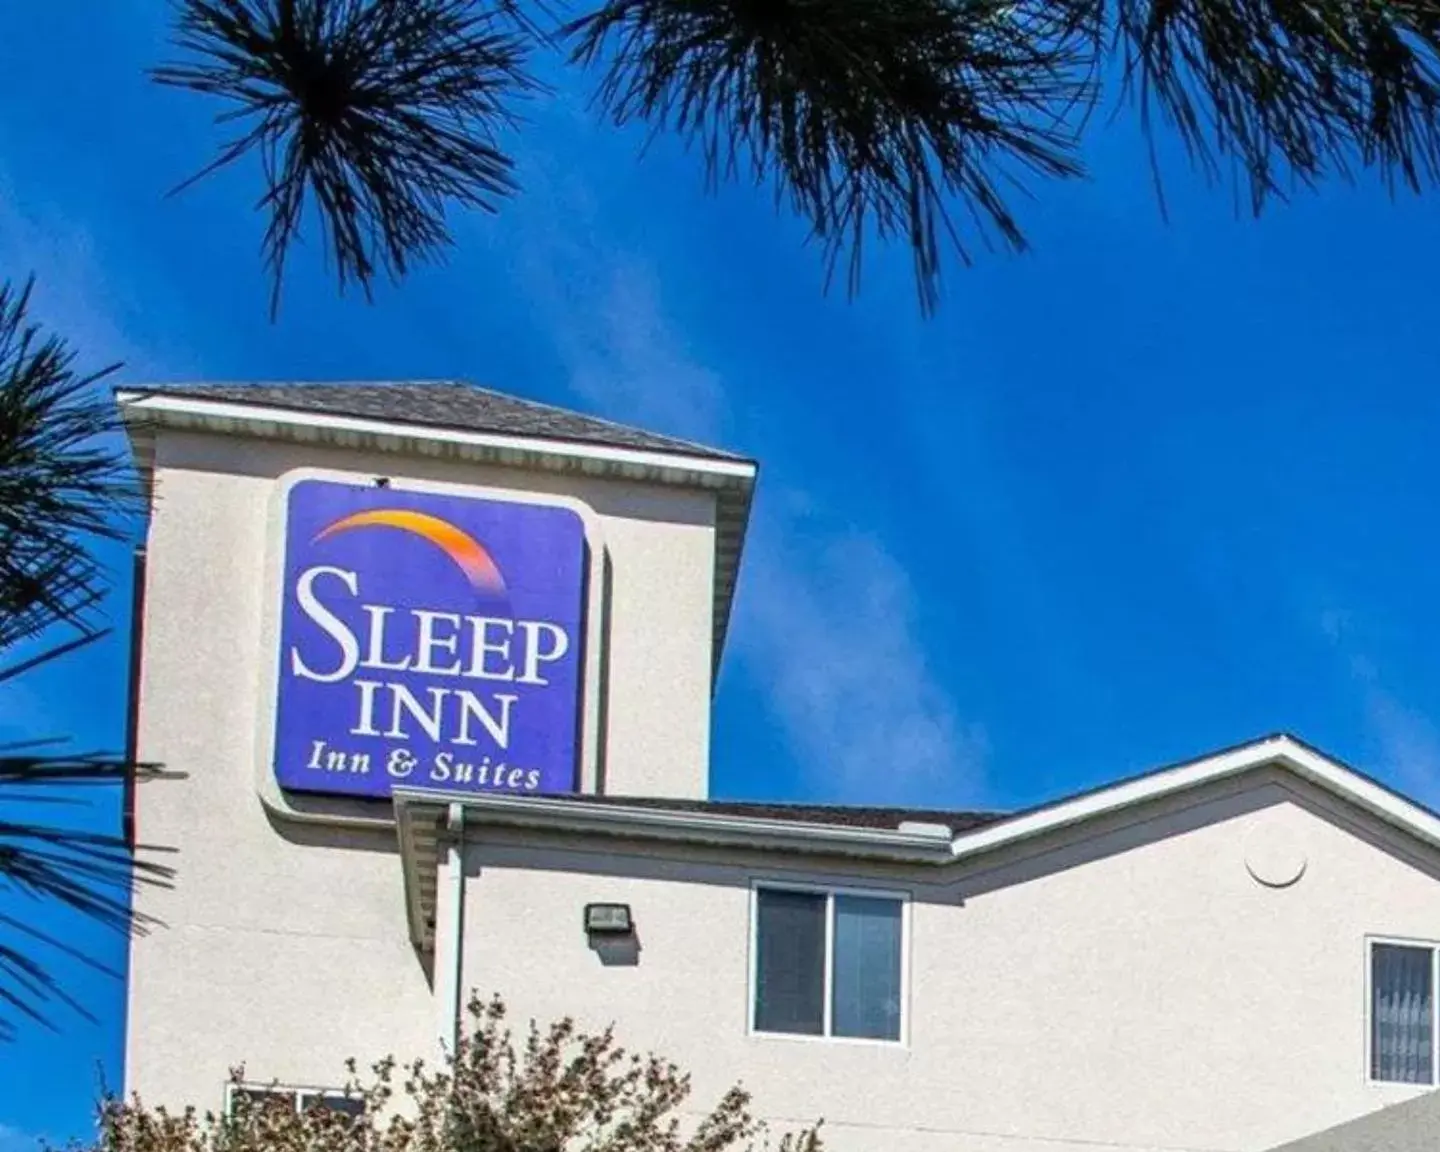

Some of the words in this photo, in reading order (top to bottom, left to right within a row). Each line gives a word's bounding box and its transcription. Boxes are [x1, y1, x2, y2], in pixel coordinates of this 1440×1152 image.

[291, 566, 569, 684] SLEEP
[351, 680, 518, 749] INN
[308, 741, 370, 773] Inn
[387, 748, 418, 777] &
[430, 752, 541, 789] Suites
